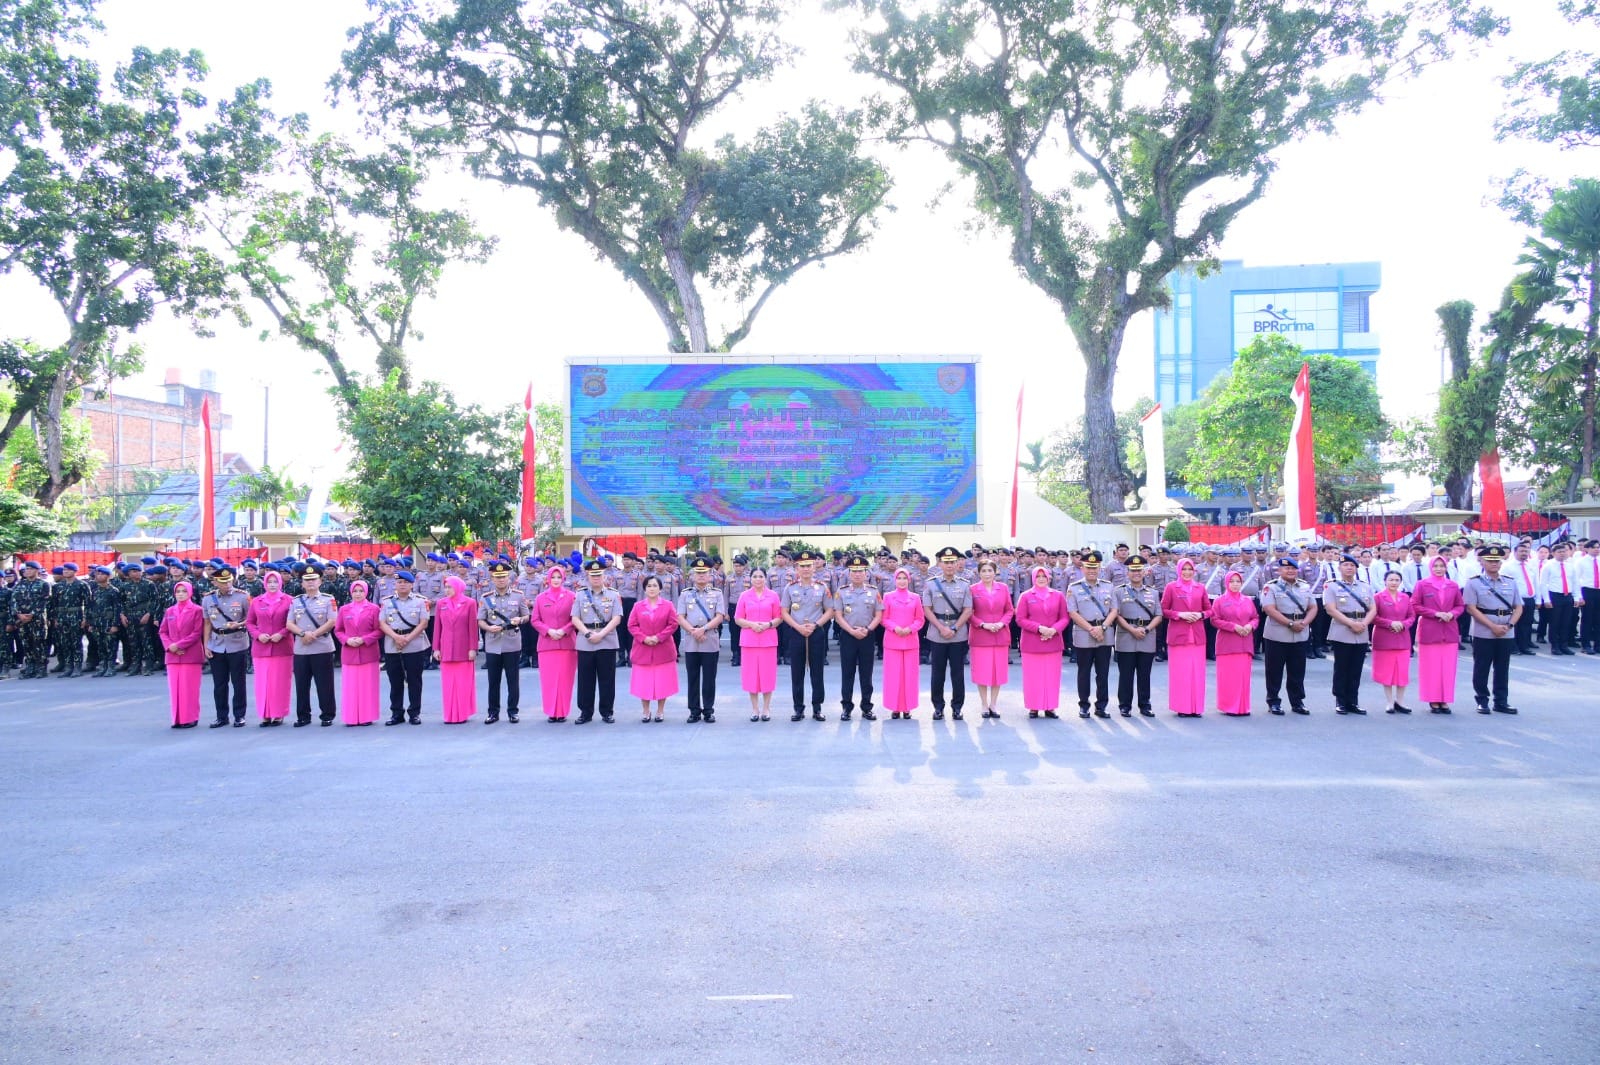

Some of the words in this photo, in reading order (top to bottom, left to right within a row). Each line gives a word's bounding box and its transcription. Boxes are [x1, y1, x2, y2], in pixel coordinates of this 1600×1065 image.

[1254, 320, 1315, 333] BPRprima
[598, 408, 698, 422] UPACARA
[859, 407, 949, 421] JABATAN
